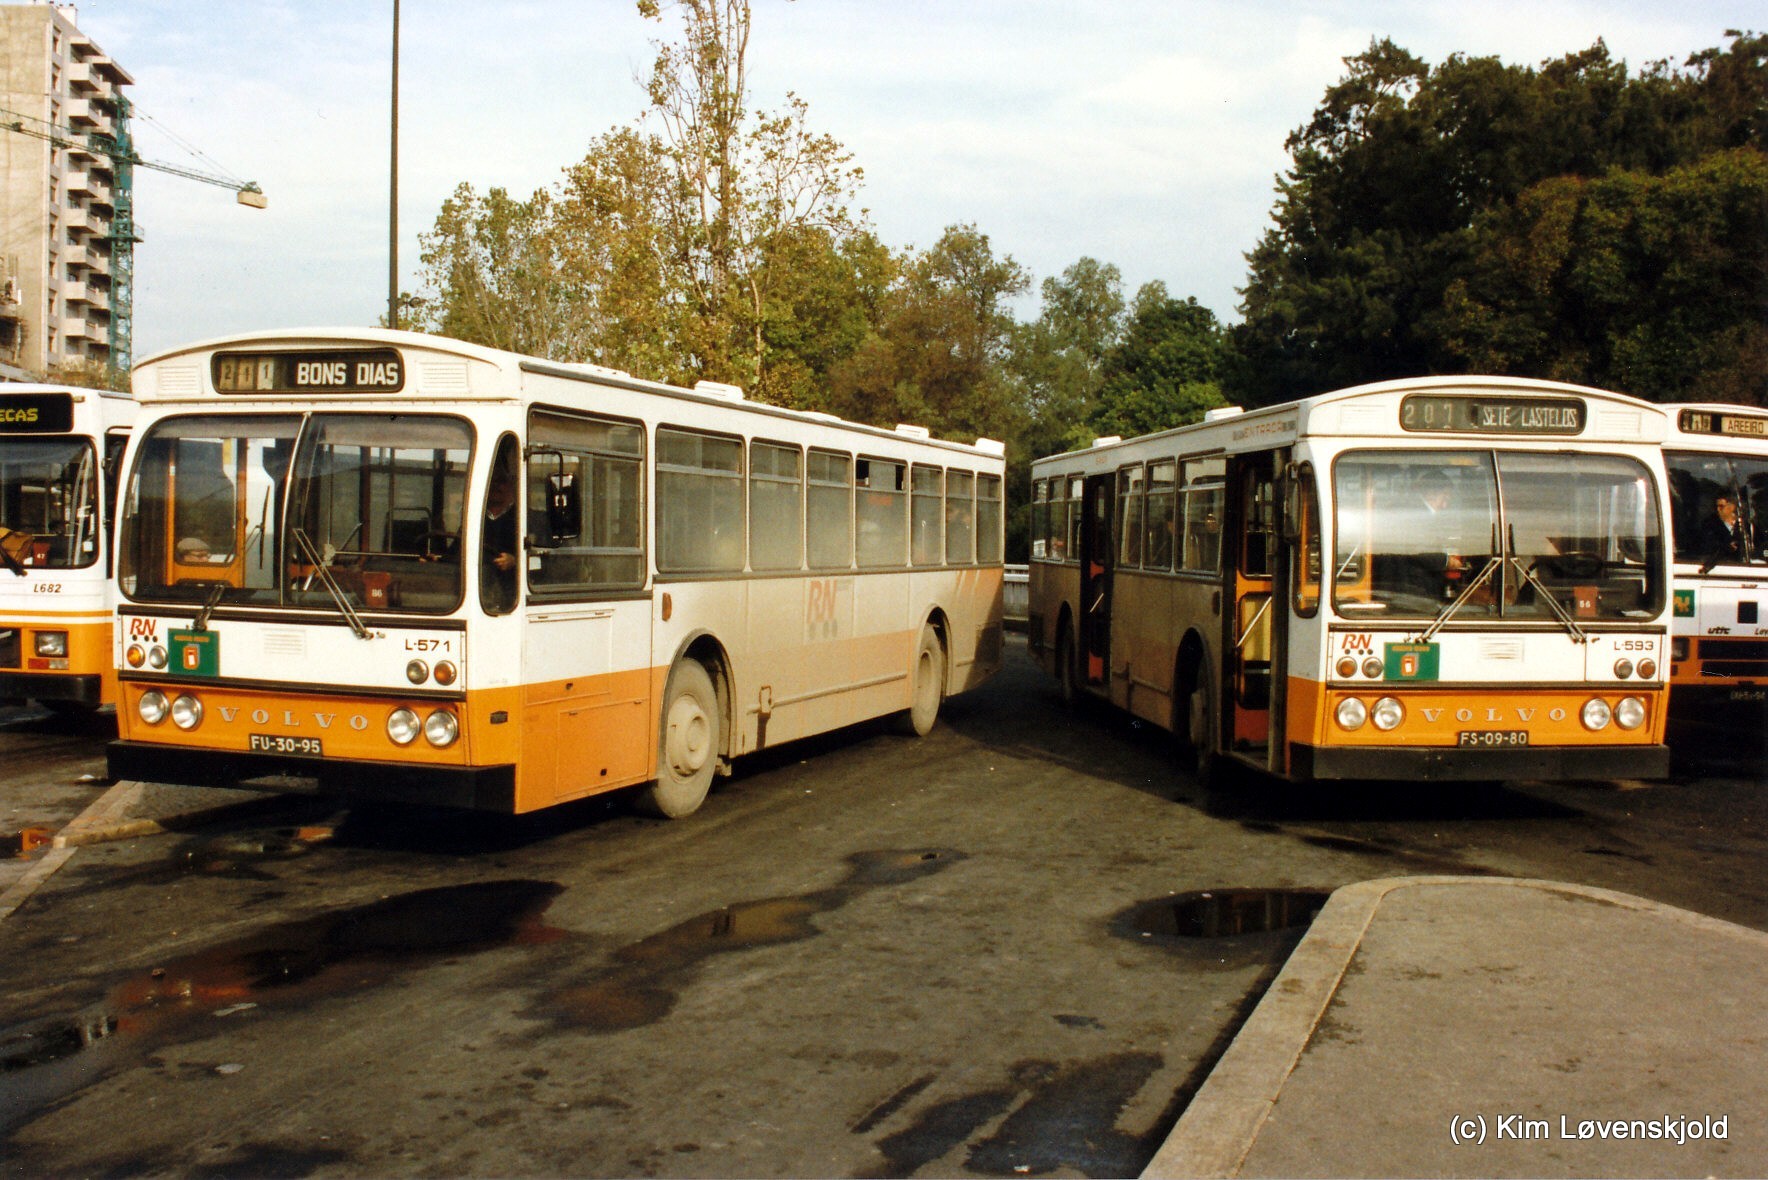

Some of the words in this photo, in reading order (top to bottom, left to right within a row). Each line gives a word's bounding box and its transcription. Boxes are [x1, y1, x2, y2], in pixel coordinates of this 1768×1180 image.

[297, 362, 347, 385] BONS
[356, 362, 399, 385] DIAS
[1482, 405, 1512, 426] SETE
[33, 583, 62, 593] L682
[807, 579, 838, 625] RN
[130, 618, 157, 635] RN
[1341, 633, 1372, 650] RN
[217, 706, 369, 731] VOLVO
[1420, 707, 1566, 723] VOLVO
[251, 735, 321, 753] FU-30-95
[1460, 731, 1527, 746] FS-09-80
